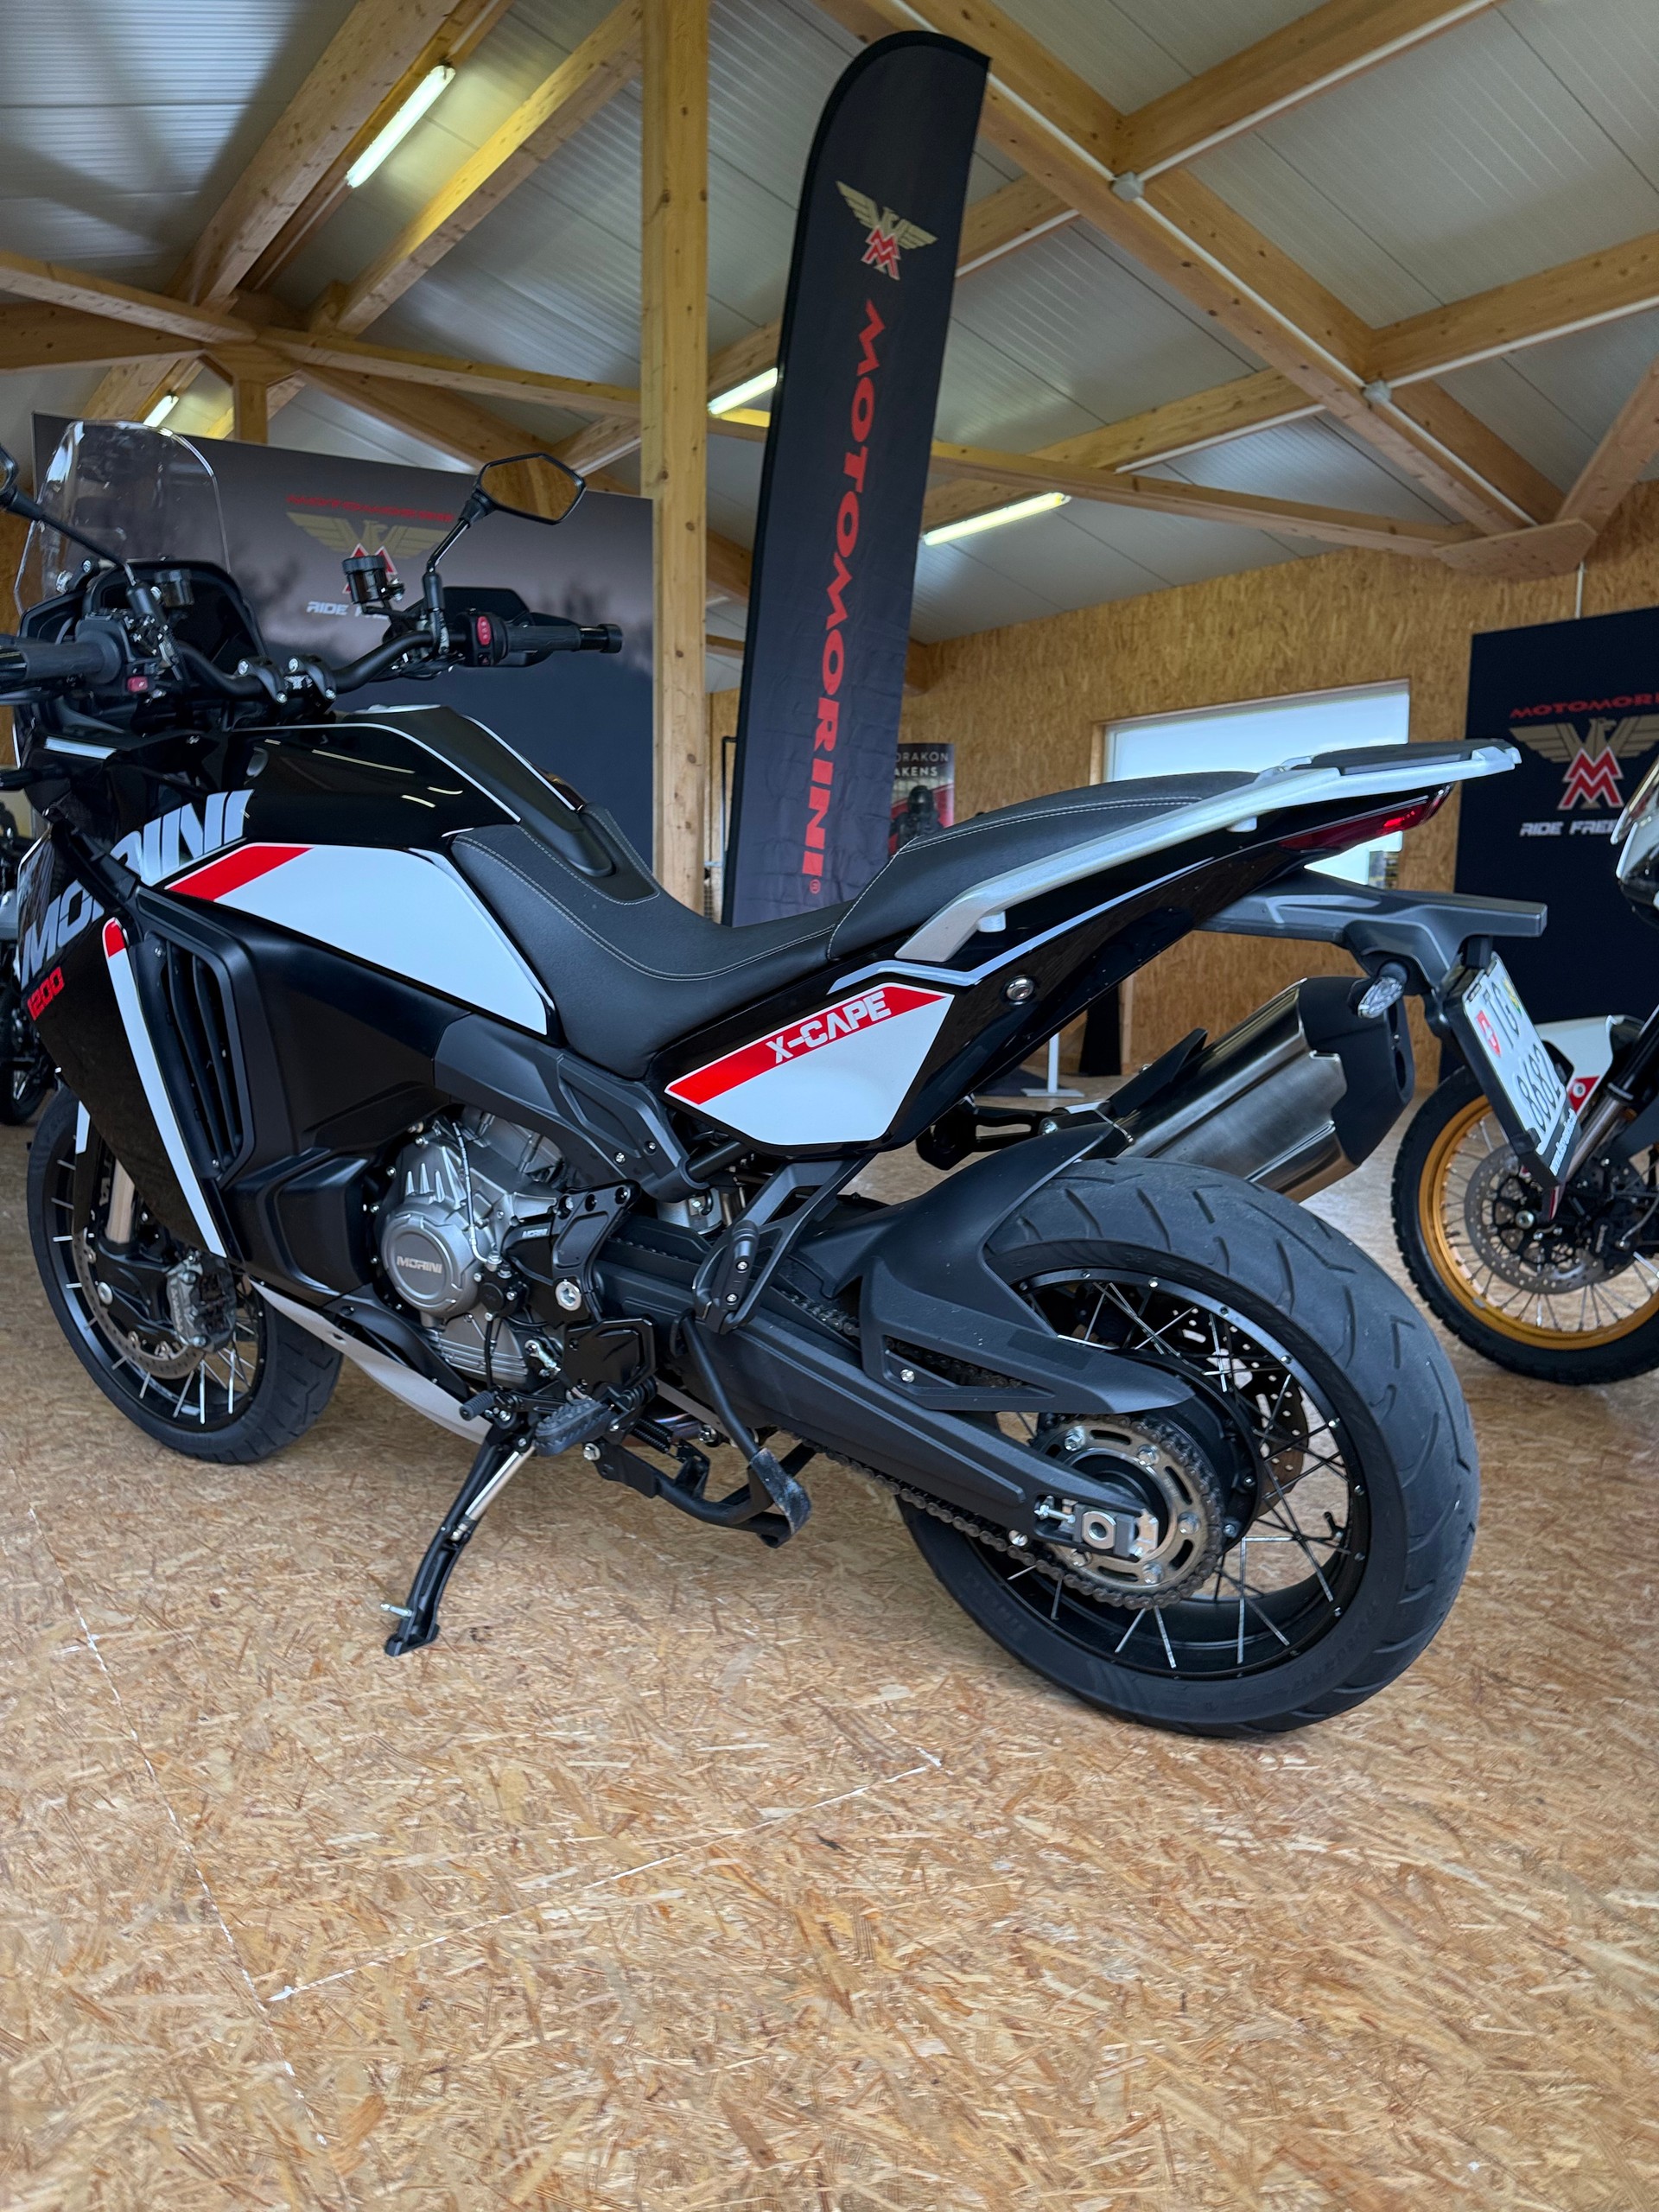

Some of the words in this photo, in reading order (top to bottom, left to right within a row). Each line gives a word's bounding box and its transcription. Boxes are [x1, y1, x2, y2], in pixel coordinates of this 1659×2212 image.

[306, 601, 348, 616] RIDE
[1519, 821, 1564, 837] RIDE
[27, 966, 65, 1020] 1200
[765, 990, 892, 1064] X-CAPE
[1516, 1043, 1561, 1133] 8682
[397, 1256, 443, 1274] MORINI
